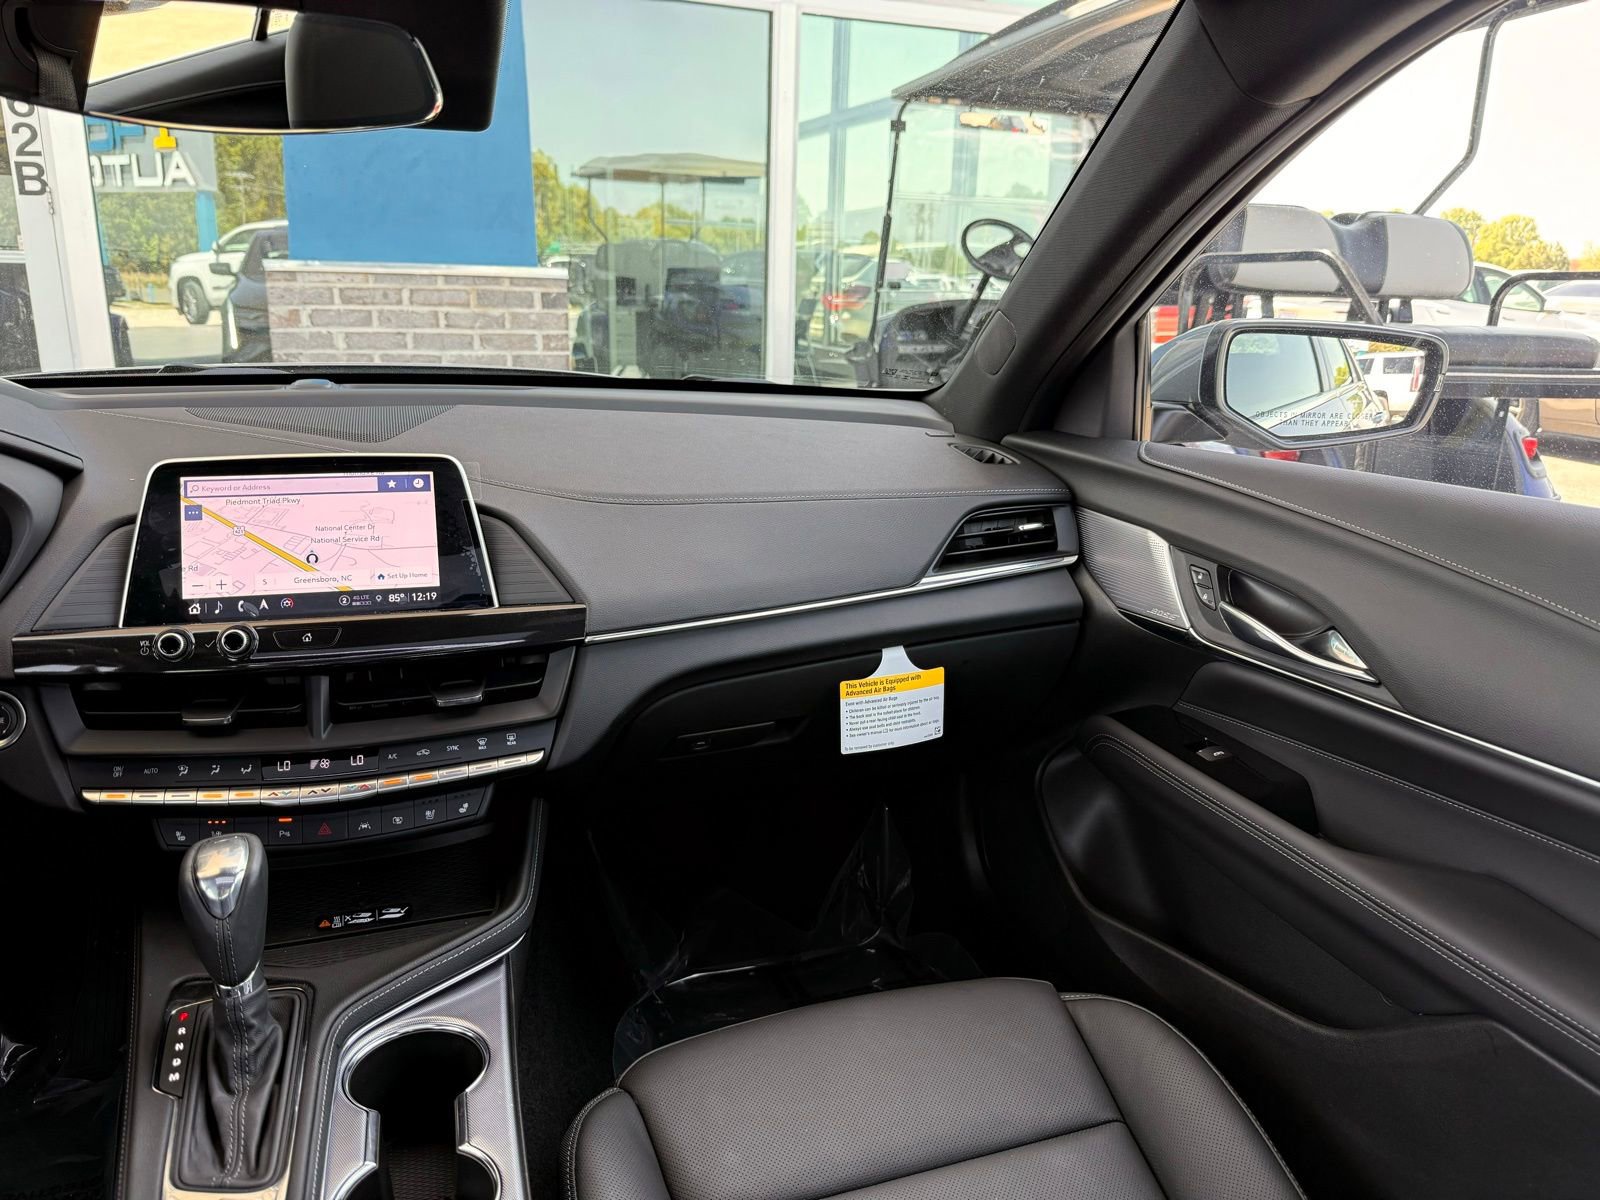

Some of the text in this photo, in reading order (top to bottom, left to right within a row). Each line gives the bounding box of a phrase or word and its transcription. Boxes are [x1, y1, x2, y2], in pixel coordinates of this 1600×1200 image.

[1255, 411, 1288, 419] OBJECTS
[1300, 412, 1326, 420] MIRROR
[201, 485, 231, 493] Keyword
[293, 576, 339, 585] Greensboro,
[411, 592, 437, 601] 12:19
[846, 681, 857, 689] This
[858, 679, 878, 688] Vehicle
[885, 675, 909, 685] Equipped
[845, 687, 872, 697] Advanced
[883, 684, 896, 693] Bags
[278, 760, 291, 771] LO
[351, 755, 364, 766] LO
[179, 1011, 190, 1021] P
[178, 1027, 186, 1035] R
[175, 1042, 184, 1051] N
[172, 1057, 182, 1067] D
[168, 1072, 180, 1082] M
